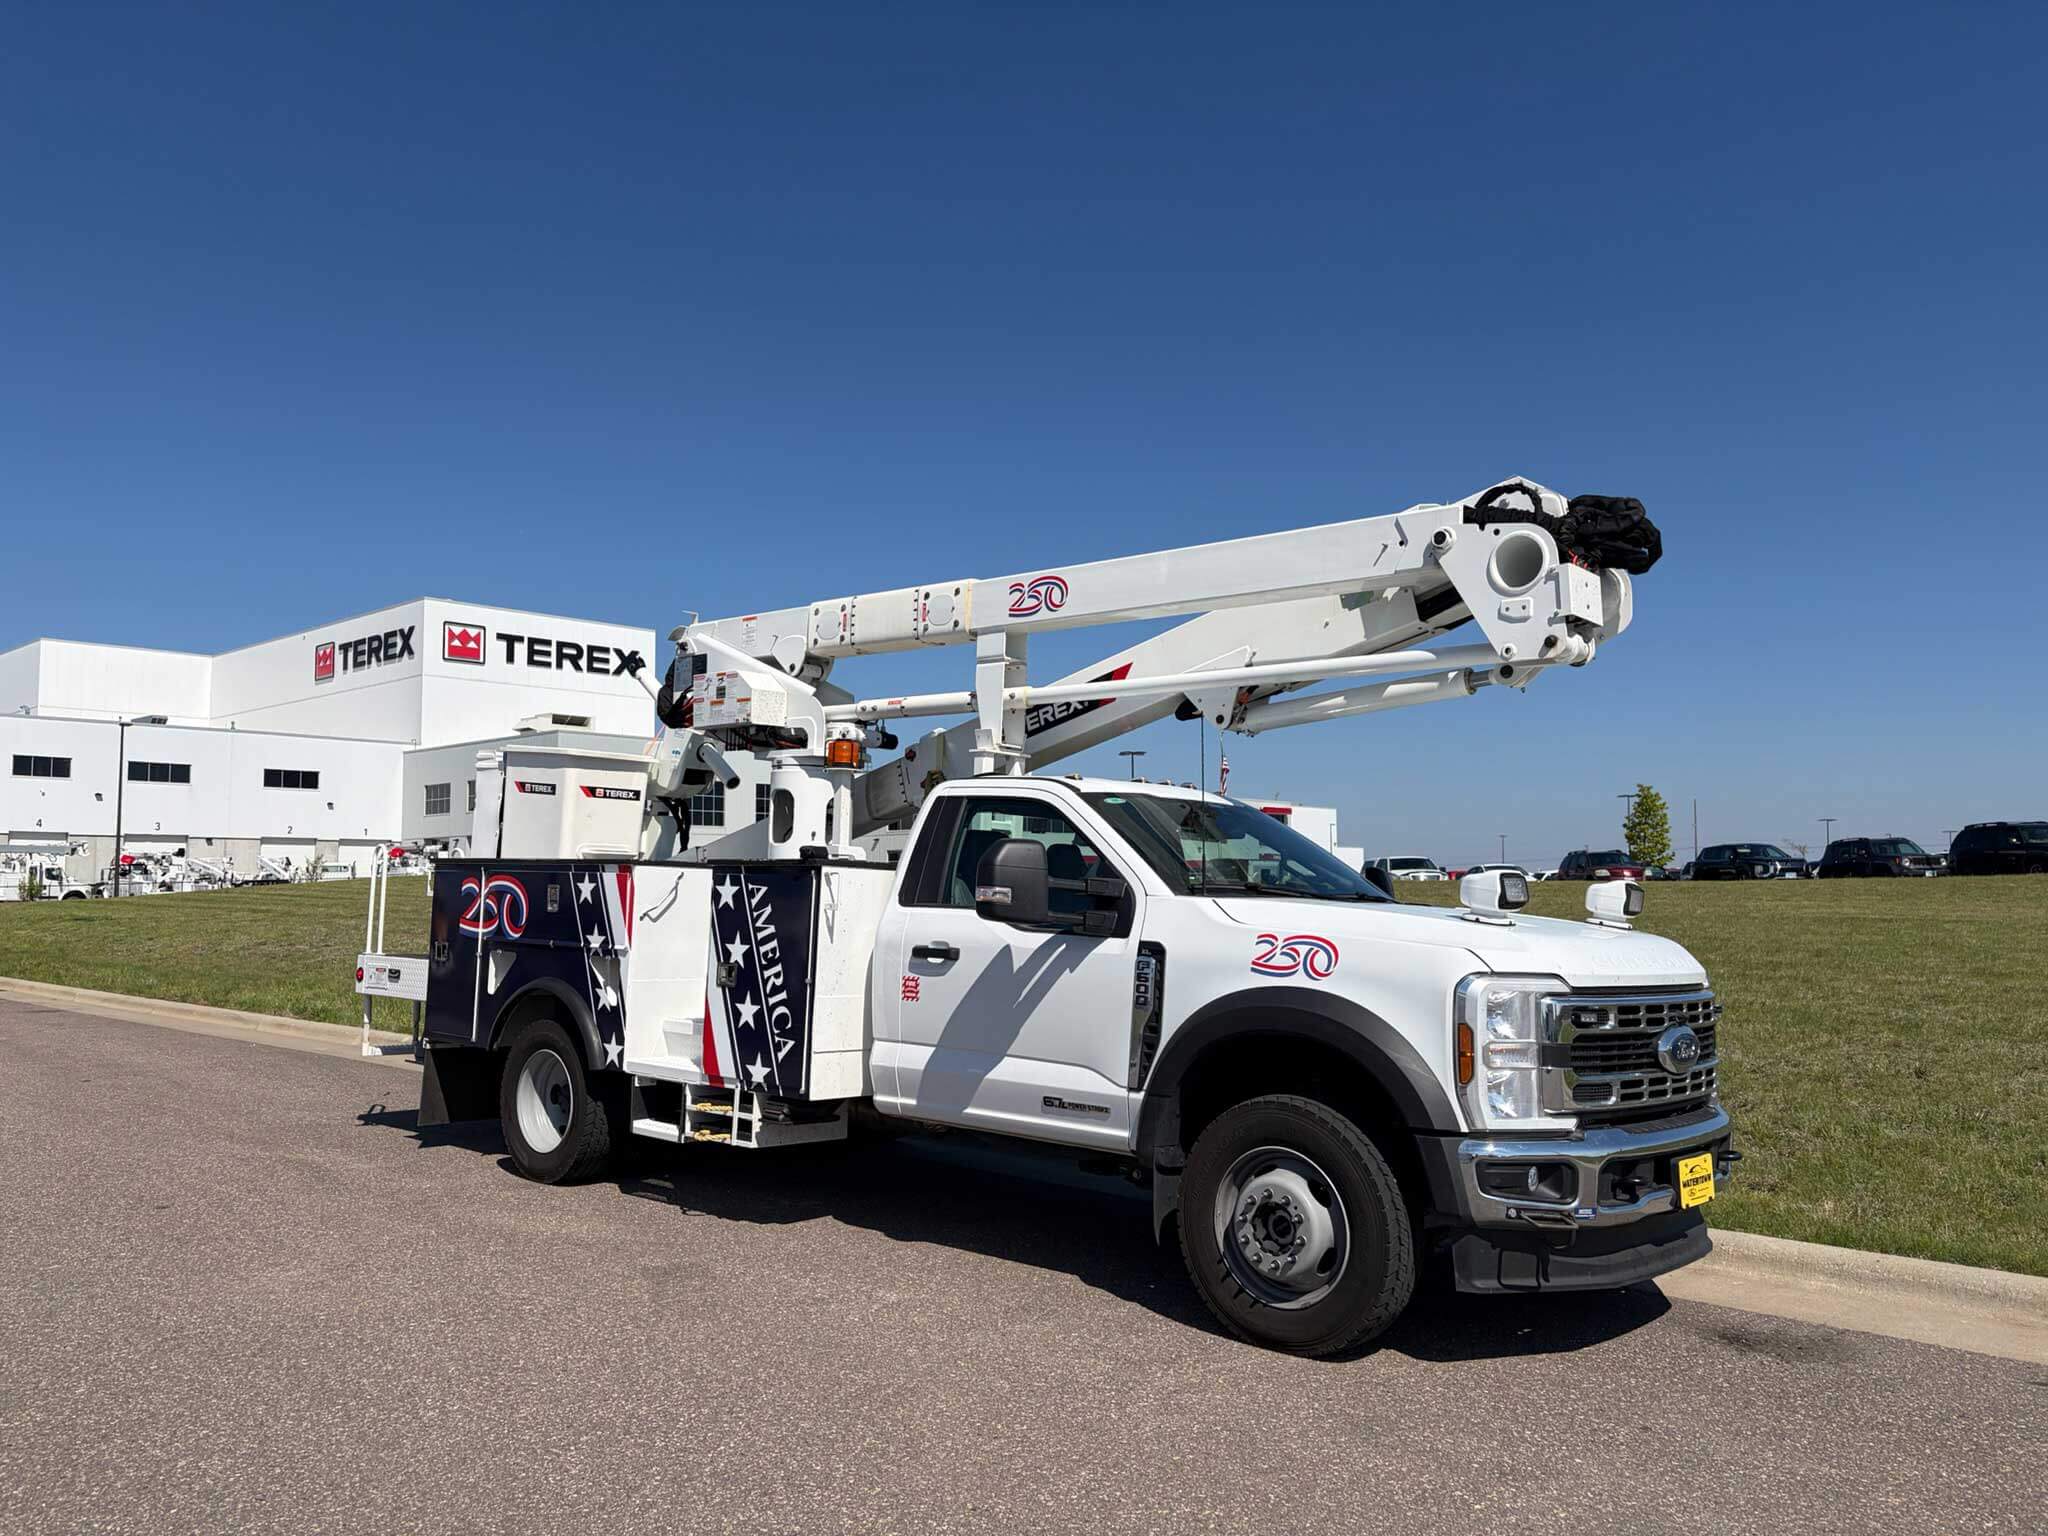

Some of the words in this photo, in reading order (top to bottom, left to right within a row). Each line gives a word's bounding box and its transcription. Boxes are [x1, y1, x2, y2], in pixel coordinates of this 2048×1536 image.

[1008, 576, 1068, 617] 250
[338, 625, 415, 672] TEREX
[496, 632, 640, 675] TEREX
[1026, 701, 1083, 732] EREX
[530, 783, 553, 793] TEREX
[605, 789, 635, 799] TEREX
[35, 818, 43, 828] 4
[153, 822, 161, 831] 3
[287, 825, 294, 835] 2
[459, 874, 529, 940] 250
[748, 883, 796, 1063] AMERICA
[1250, 933, 1339, 981] 250
